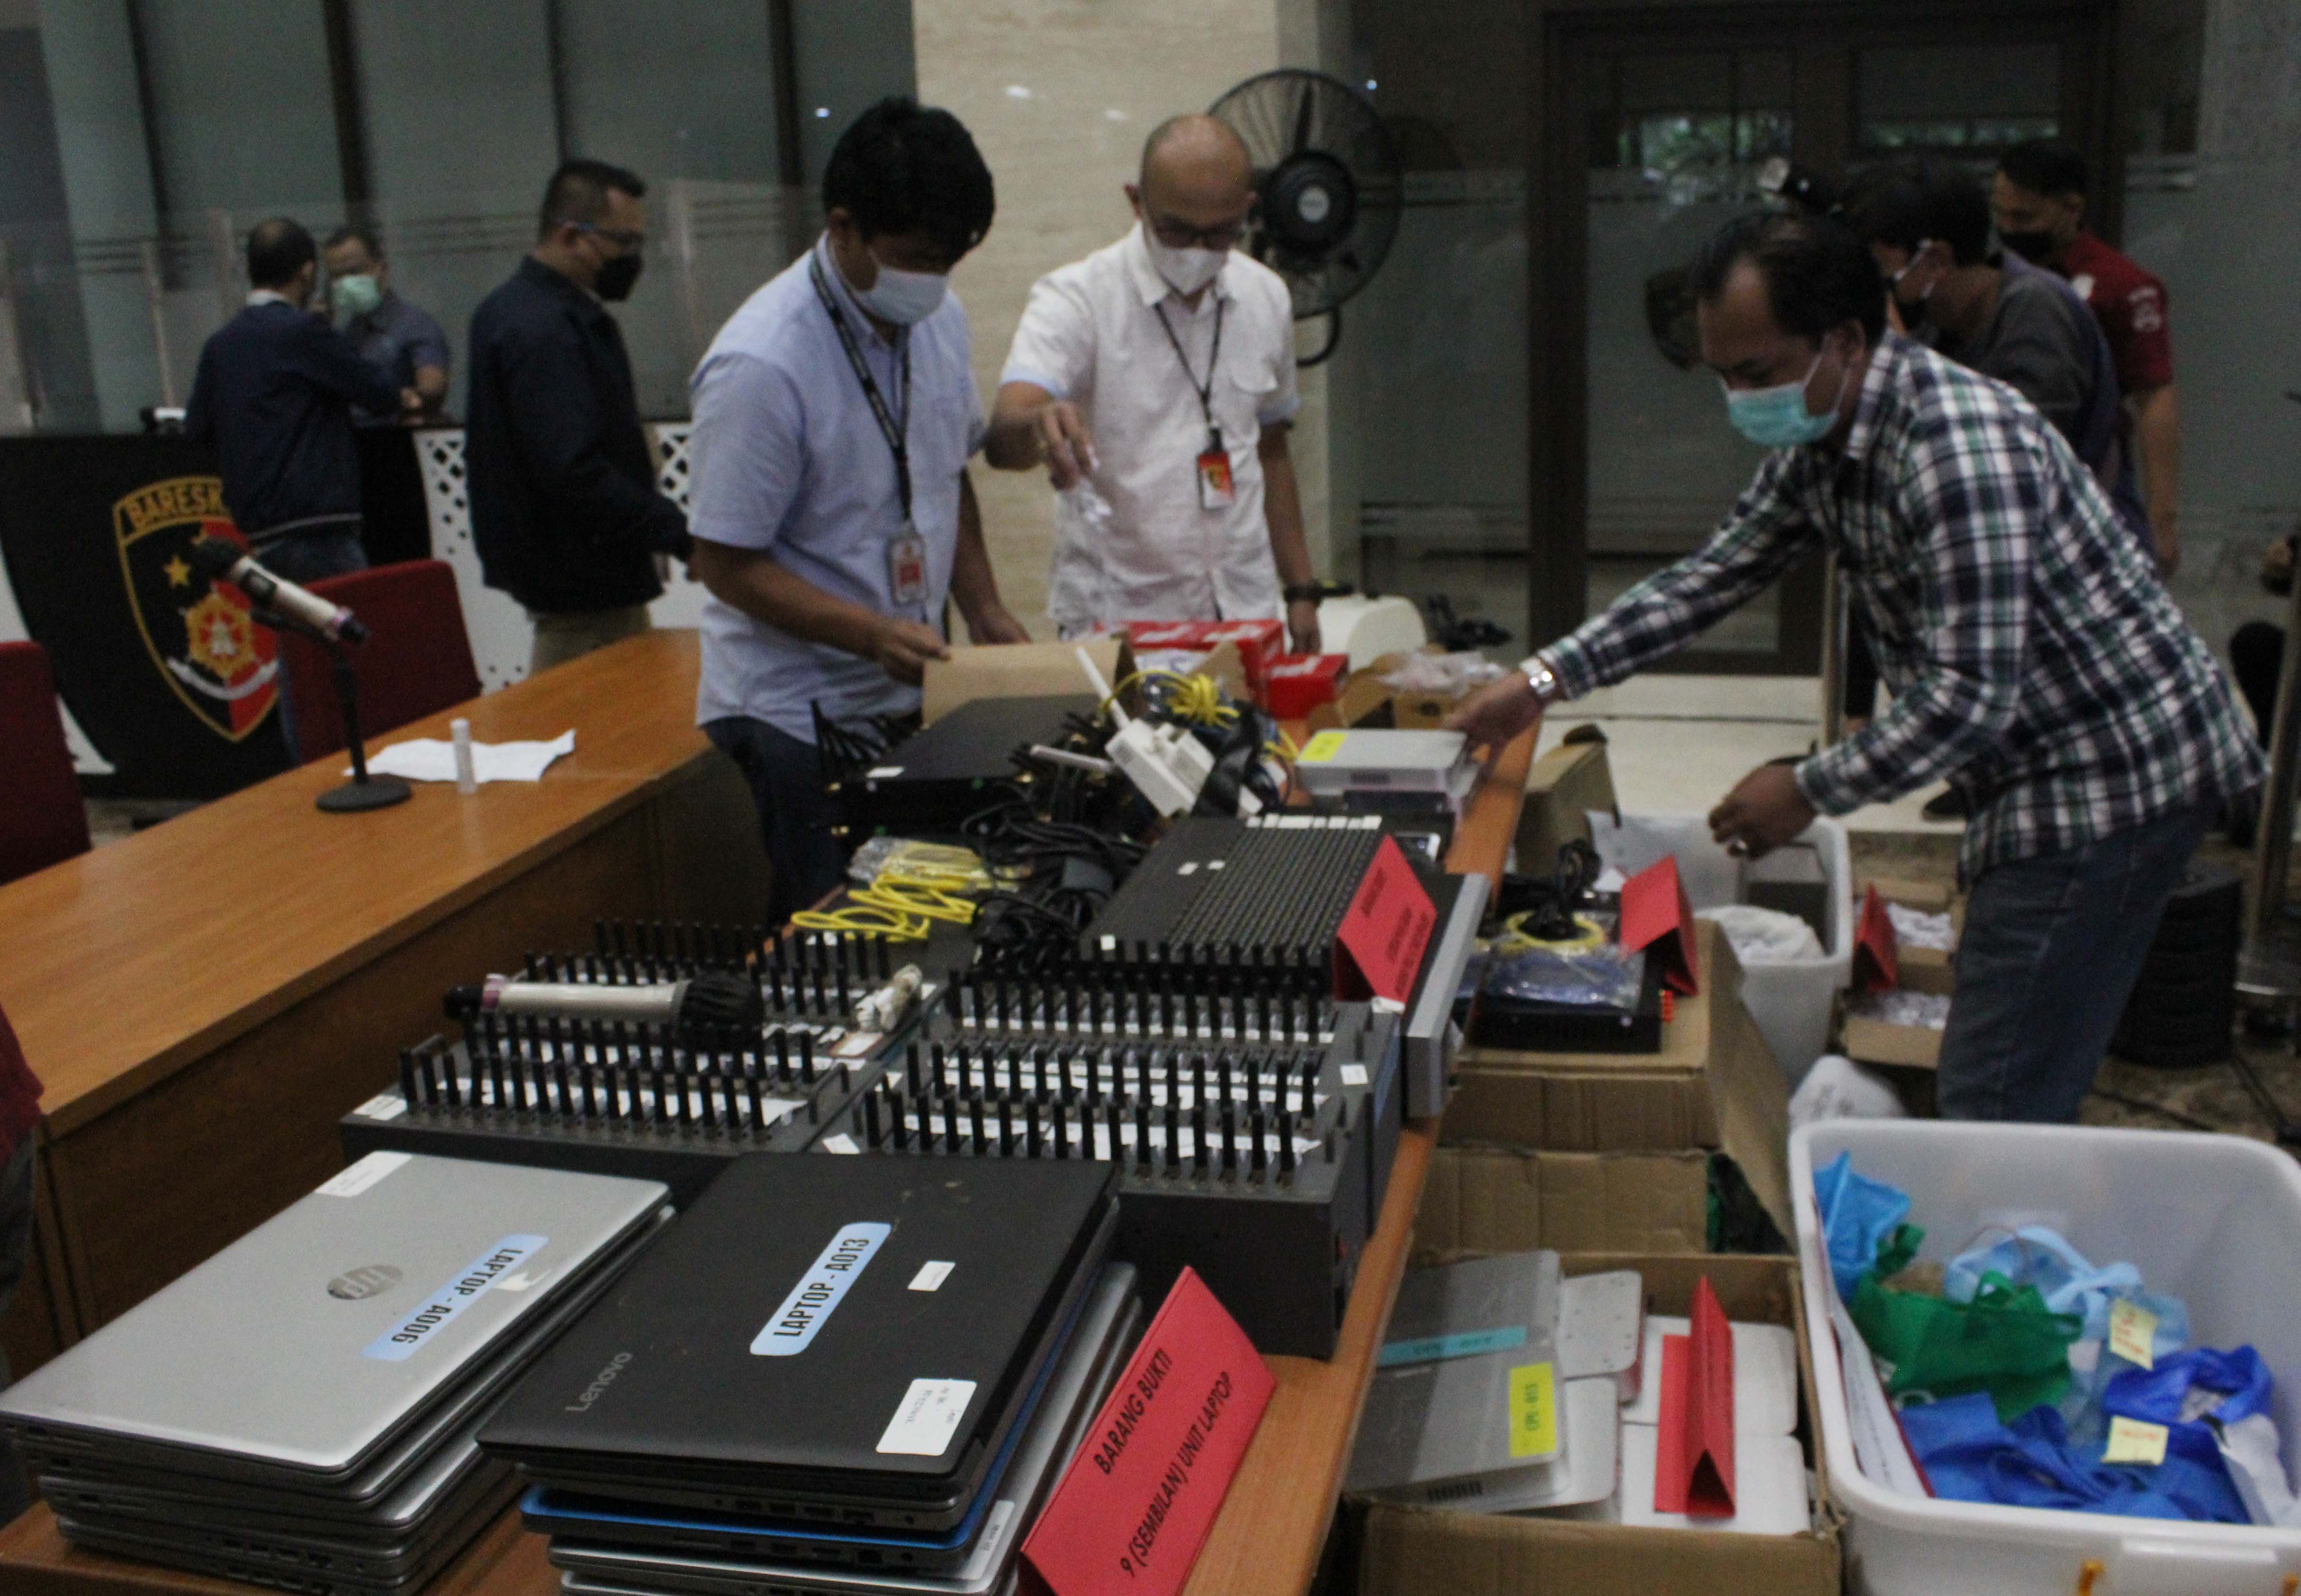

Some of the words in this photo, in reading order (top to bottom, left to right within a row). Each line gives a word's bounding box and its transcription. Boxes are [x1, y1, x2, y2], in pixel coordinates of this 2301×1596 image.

[455, 1249, 524, 1295] LAPTOP
[773, 1283, 833, 1336] LAPTOP
[824, 1238, 869, 1271] A013
[391, 1304, 452, 1343] A006
[565, 1352, 633, 1411] Lenovo
[1093, 1393, 1145, 1475] BARANG
[1137, 1348, 1173, 1400] BUKTI
[1120, 1557, 1135, 1578] 9
[1129, 1462, 1189, 1568] (SEMBILAN)
[1178, 1425, 1206, 1468] UNIT
[1197, 1371, 1233, 1432] LAPTOP
